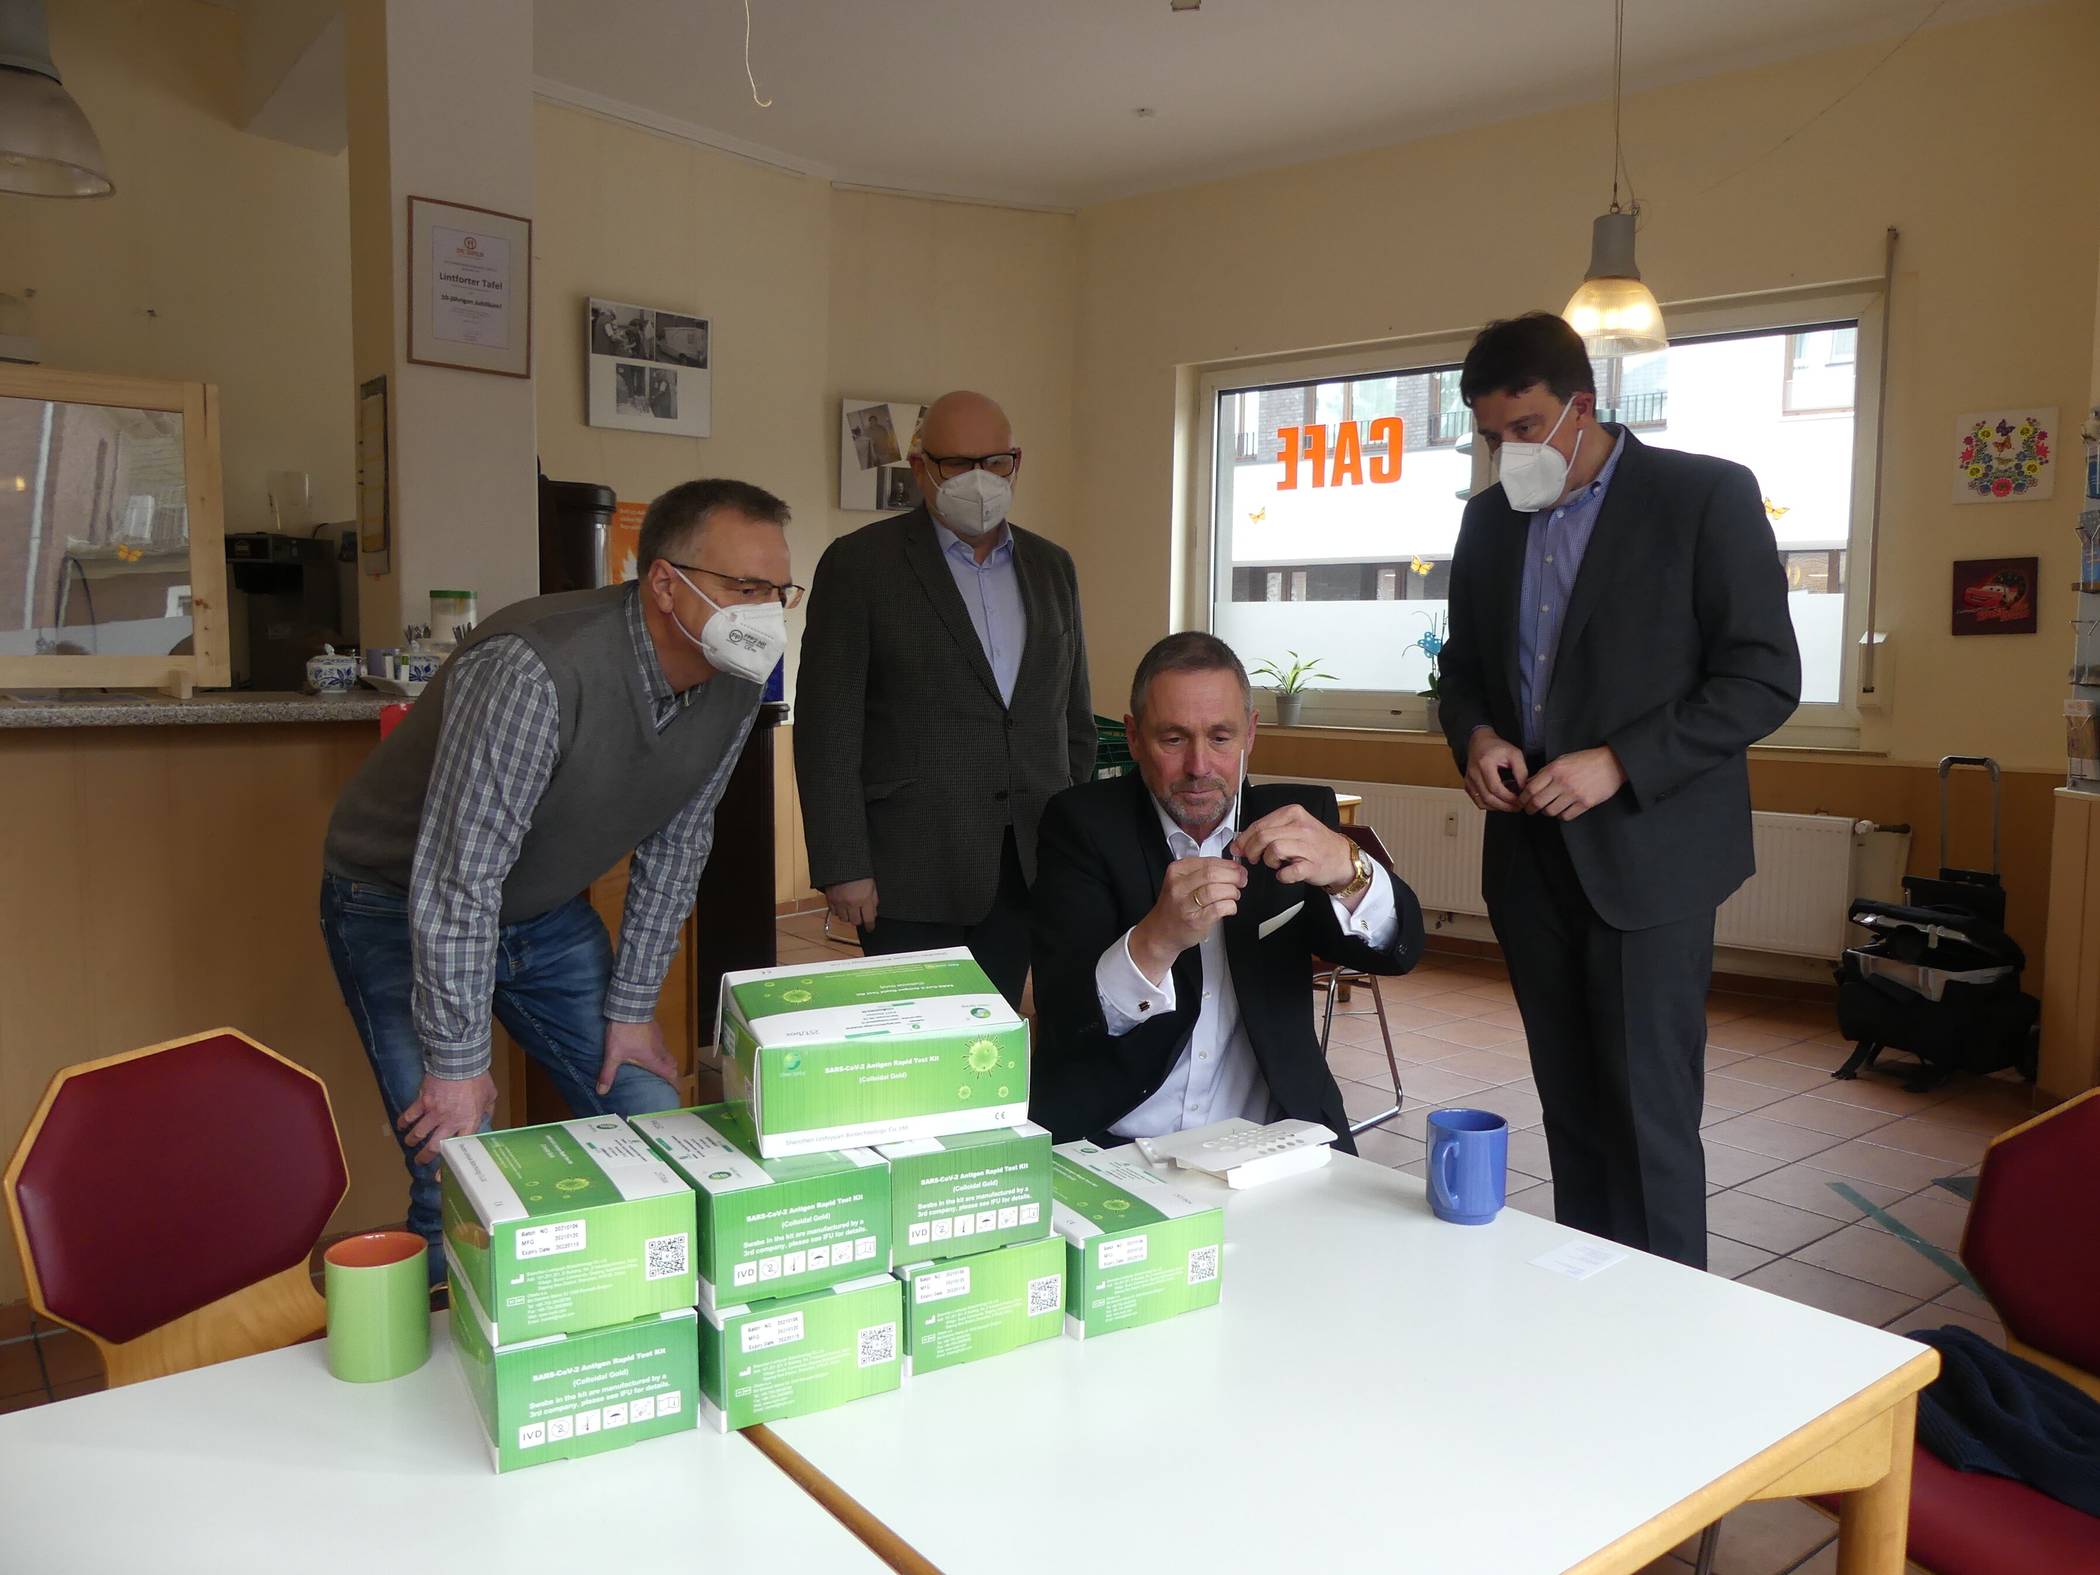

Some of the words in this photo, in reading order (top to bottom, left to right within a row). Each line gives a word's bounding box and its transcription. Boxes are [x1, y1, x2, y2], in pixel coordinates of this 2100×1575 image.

[440, 272, 480, 287] Lintforter
[482, 280, 503, 290] Tafel
[825, 1064, 865, 1074] SARS-CoV-2
[866, 1061, 893, 1070] Antigen
[893, 1059, 913, 1067] Rapid
[859, 1075, 889, 1084] (Colloidal
[890, 1072, 907, 1080] Gold)
[921, 1174, 959, 1186] SARS-CoV-2
[960, 1171, 984, 1179] Antigen
[985, 1166, 1003, 1175] Rapid
[1004, 1164, 1018, 1172] Test
[953, 1181, 981, 1193] (Colloidal
[982, 1179, 998, 1187] Gold)
[746, 1209, 788, 1222] SARS-CoV-2
[789, 1204, 815, 1214] Antigen
[816, 1199, 836, 1208] Rapid
[836, 1196, 852, 1204] Test
[853, 1193, 864, 1201] Kit
[918, 1202, 938, 1210] Swabs
[976, 1188, 1015, 1200] manufactured
[929, 1207, 958, 1216] company,
[959, 1203, 978, 1211] please
[1011, 1194, 1032, 1202] details.
[781, 1216, 813, 1229] (Colloidal
[813, 1212, 831, 1222] Gold)
[744, 1240, 765, 1249] Swabs
[807, 1220, 850, 1236] manufactured
[744, 1249, 755, 1257] 3rd
[756, 1244, 788, 1254] company,
[788, 1238, 810, 1248] please
[822, 1232, 834, 1240] IFU
[845, 1227, 868, 1236] details.
[912, 1228, 928, 1238] IVD
[737, 1268, 755, 1279] IVD
[533, 1366, 580, 1382] SARS-CoV-2
[581, 1360, 611, 1371] Antigen
[612, 1354, 635, 1364] Rapid
[635, 1350, 653, 1359] Test
[654, 1347, 666, 1355] Kit
[573, 1373, 608, 1388] (Colloidal
[608, 1368, 629, 1378] Gold)
[529, 1400, 554, 1410] Swabs
[601, 1376, 651, 1392] manufactured
[529, 1410, 542, 1418] 3rd
[543, 1403, 580, 1414] company,
[580, 1396, 605, 1407] please
[620, 1389, 633, 1397] IFU
[645, 1382, 671, 1391] details.
[523, 1430, 542, 1441] IVD
